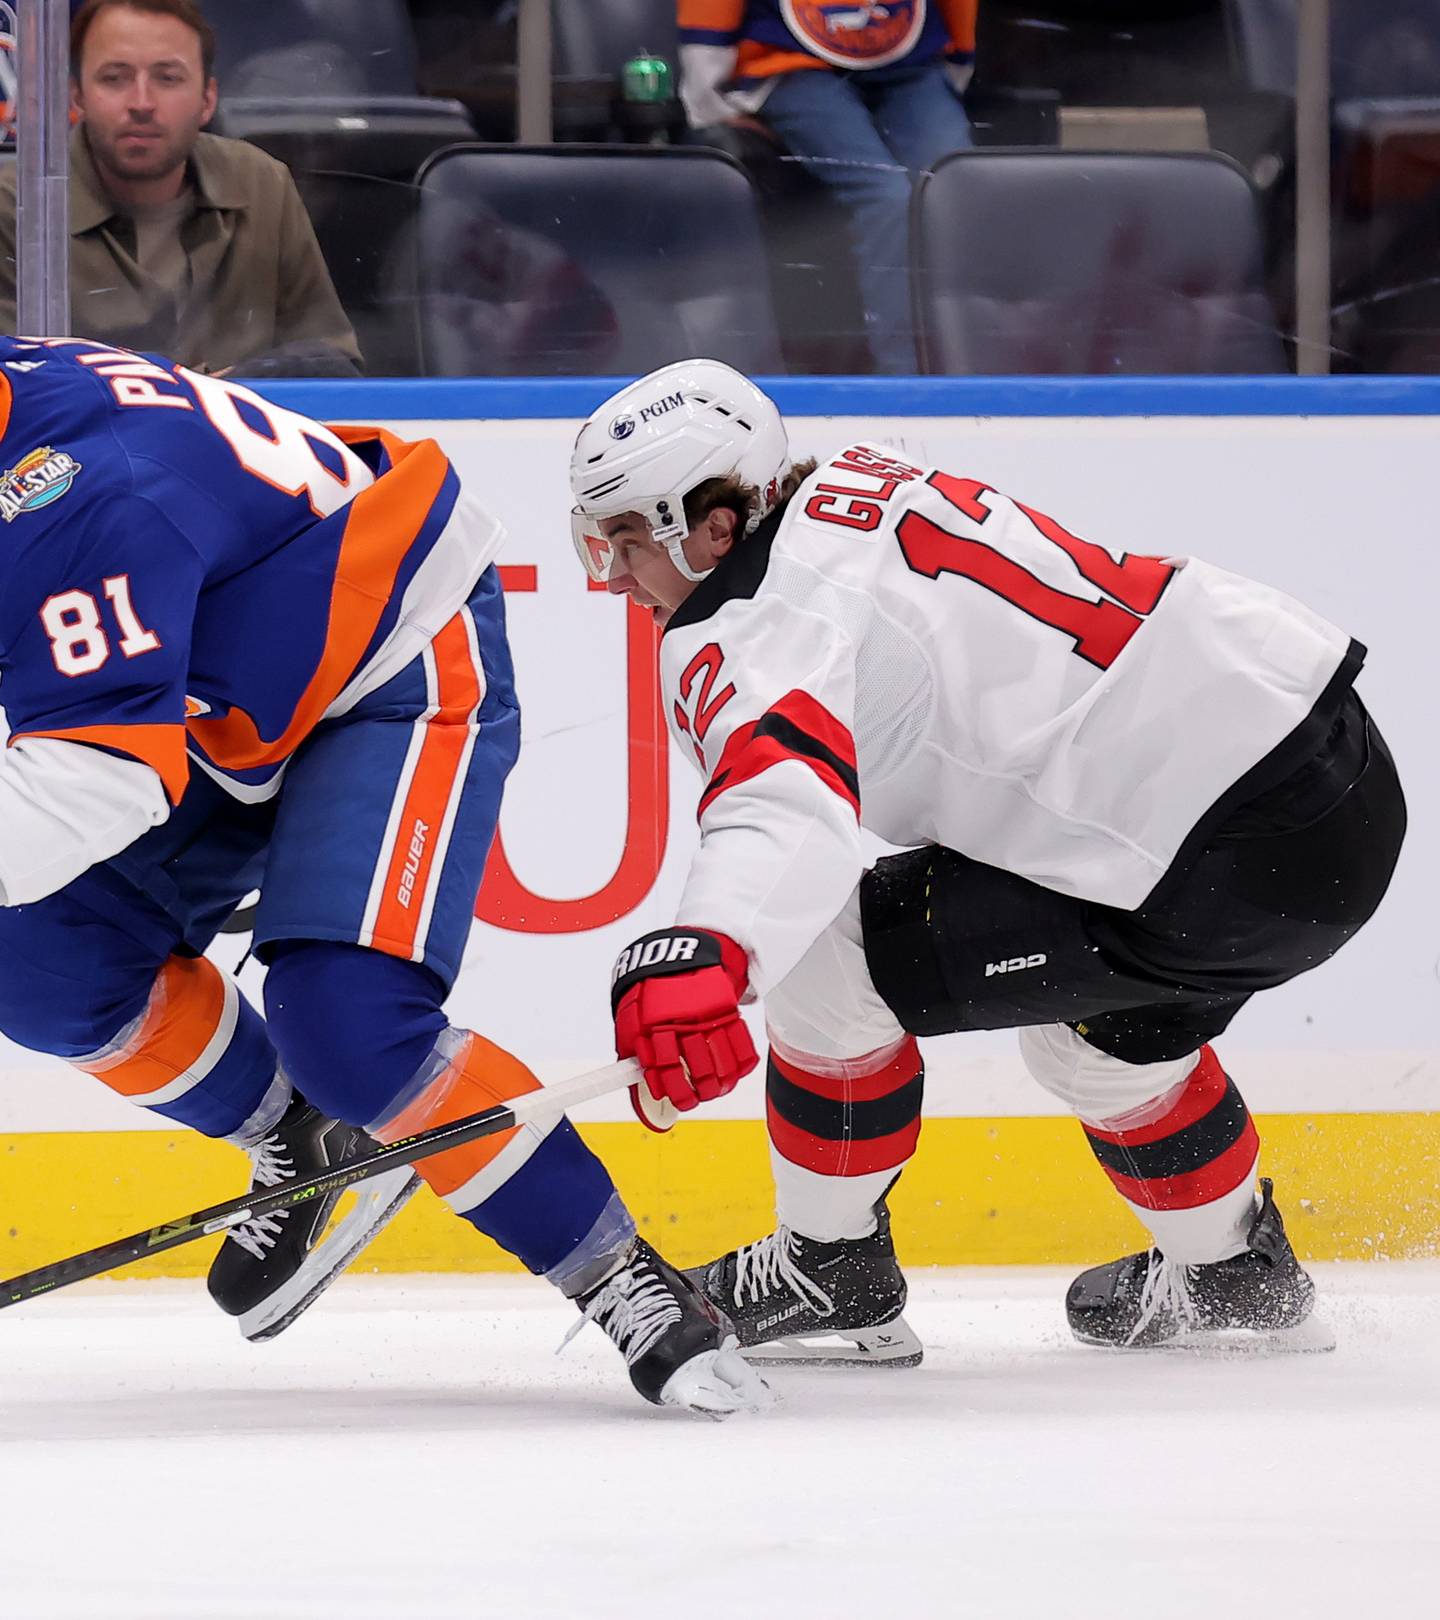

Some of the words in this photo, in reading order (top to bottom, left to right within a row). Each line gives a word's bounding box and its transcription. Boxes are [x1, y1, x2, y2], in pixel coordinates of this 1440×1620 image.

[639, 391, 685, 424] PGIM
[894, 469, 1177, 672] 12
[39, 573, 162, 678] 81
[985, 953, 1047, 977] CCM
[317, 1167, 369, 1193] ALPHA
